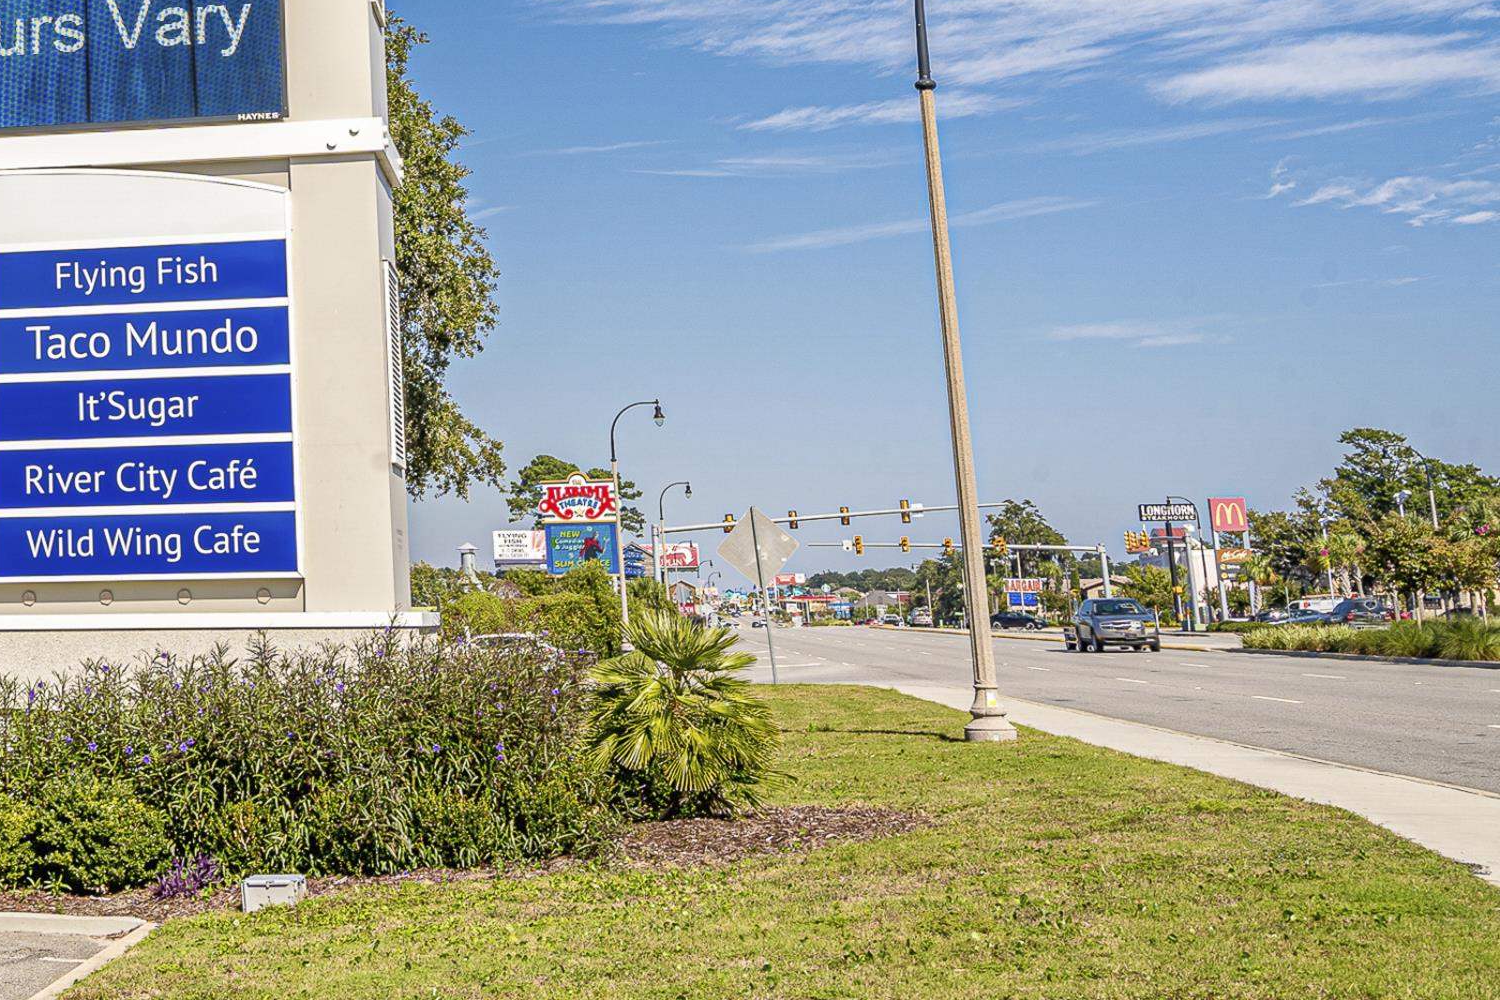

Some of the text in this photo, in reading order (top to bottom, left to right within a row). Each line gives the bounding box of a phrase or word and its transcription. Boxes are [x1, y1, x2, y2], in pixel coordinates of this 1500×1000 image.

[237, 112, 279, 121] HAYNES
[54, 256, 218, 293] Flying Fish
[26, 318, 258, 360] Taco Mundo
[77, 391, 198, 427] It'Sugar
[25, 459, 257, 498] River City Café
[26, 523, 261, 562] Wild Wing Cafe
